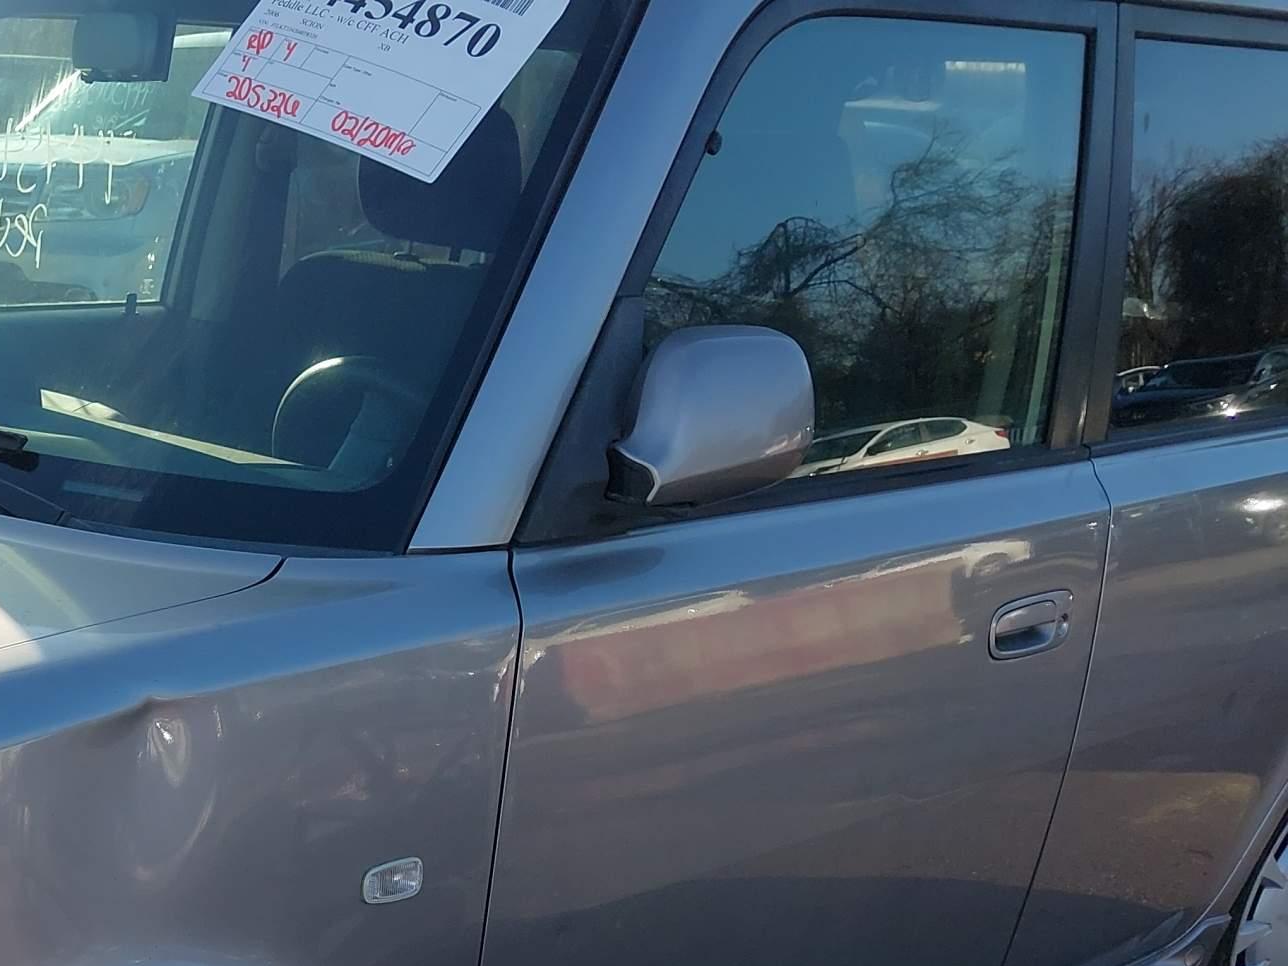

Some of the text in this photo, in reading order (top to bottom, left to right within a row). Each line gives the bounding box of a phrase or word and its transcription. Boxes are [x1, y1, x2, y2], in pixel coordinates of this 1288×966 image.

[304, 4, 330, 18] LLC
[337, 15, 355, 27] w/c
[380, 28, 410, 44] ACH
